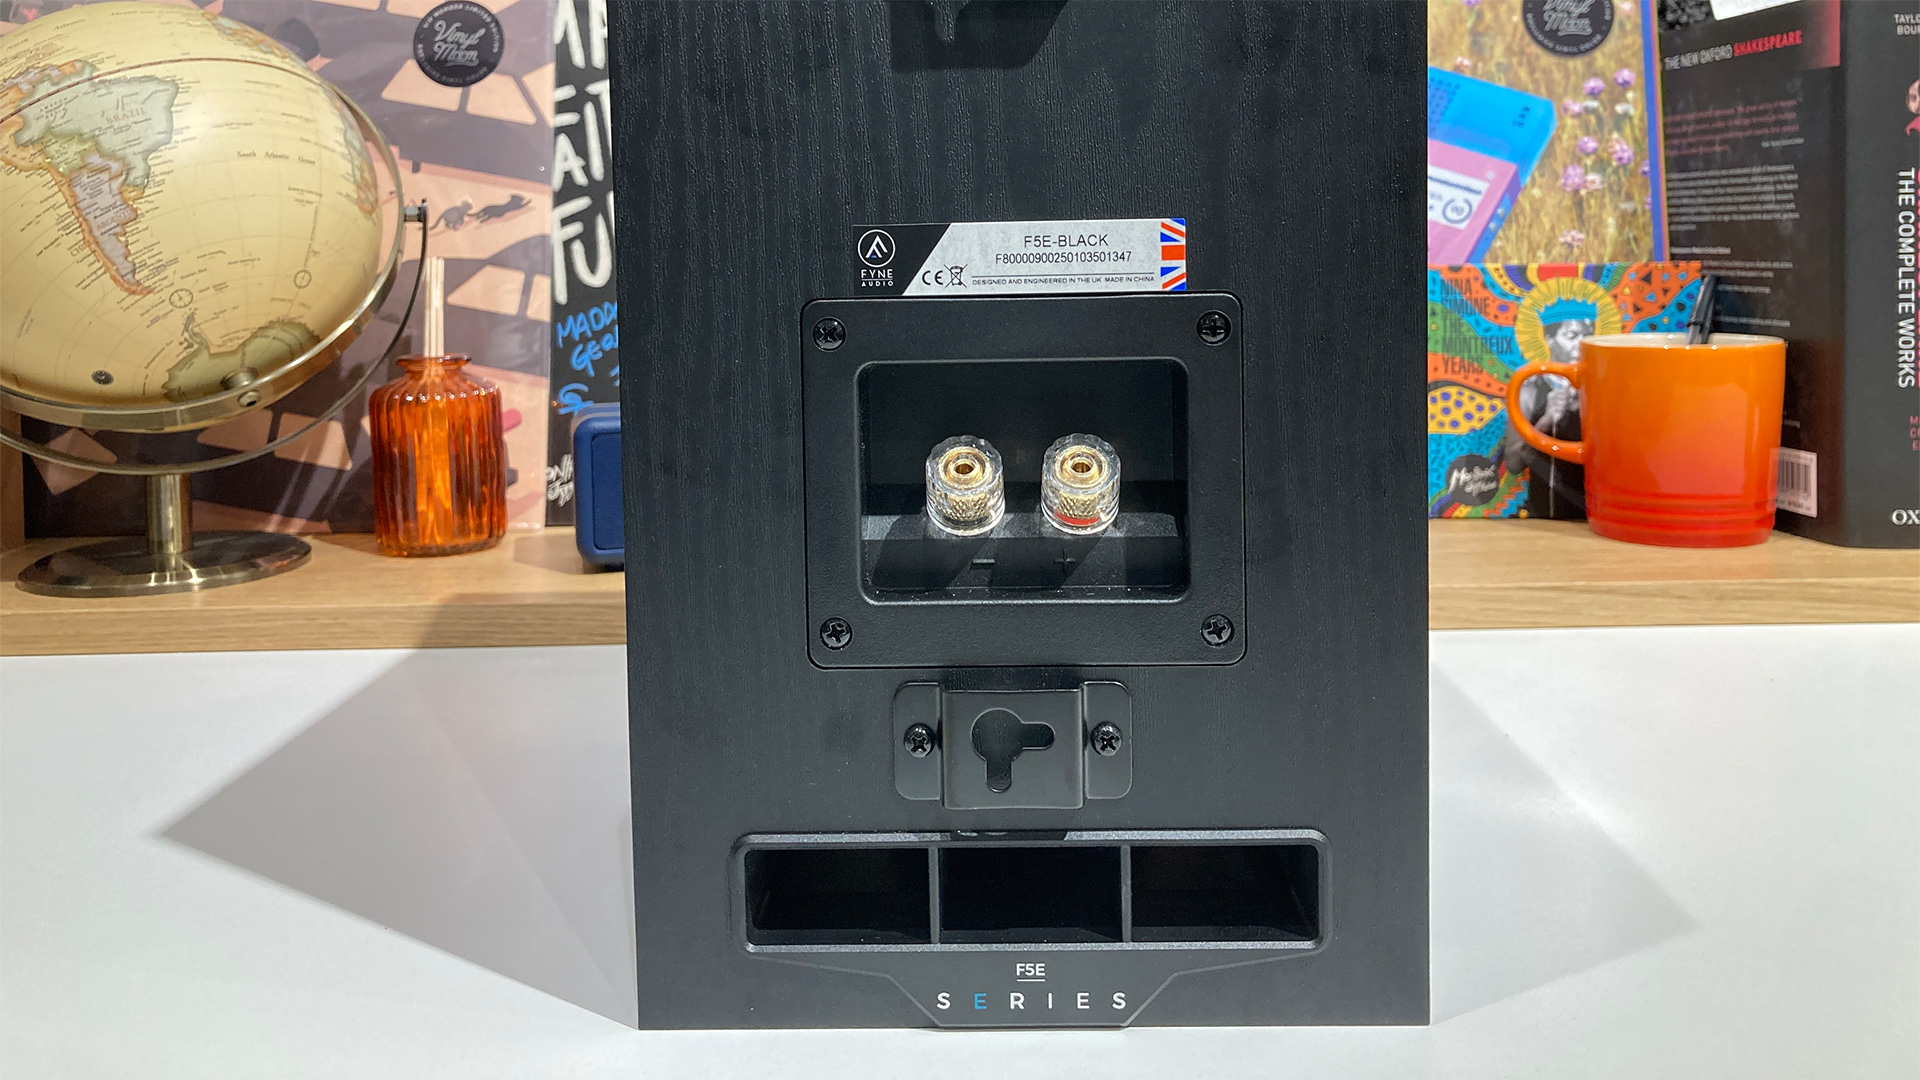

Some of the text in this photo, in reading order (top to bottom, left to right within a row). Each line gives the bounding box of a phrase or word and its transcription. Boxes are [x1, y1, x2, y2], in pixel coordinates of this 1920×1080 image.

[1543, 10, 1593, 37] Moon
[434, 20, 486, 50] Vinyl
[1733, 29, 1802, 57] SHAKESPEARE
[433, 41, 480, 67] Moon
[106, 106, 147, 125] BRAZIL
[1023, 233, 1109, 248] F5E-BLACK
[995, 250, 1132, 264] F80000900250103501347
[861, 268, 894, 279] FYNE
[921, 270, 944, 286] CE
[972, 278, 1007, 286] DESIGNED
[1024, 277, 1068, 285] ENGINEERED
[1092, 276, 1102, 284] UK
[1133, 275, 1155, 283] CHINA
[1898, 167, 1916, 389] THE COMPLETE WORKS
[1440, 278, 1472, 297] NINA
[1440, 297, 1490, 316] SIMONE
[1441, 315, 1465, 334] THE
[1441, 335, 1514, 355] MONTREUX
[1442, 355, 1484, 375] YEARS
[1016, 963, 1046, 976] F5E
[936, 992, 1127, 1010] SERIES
